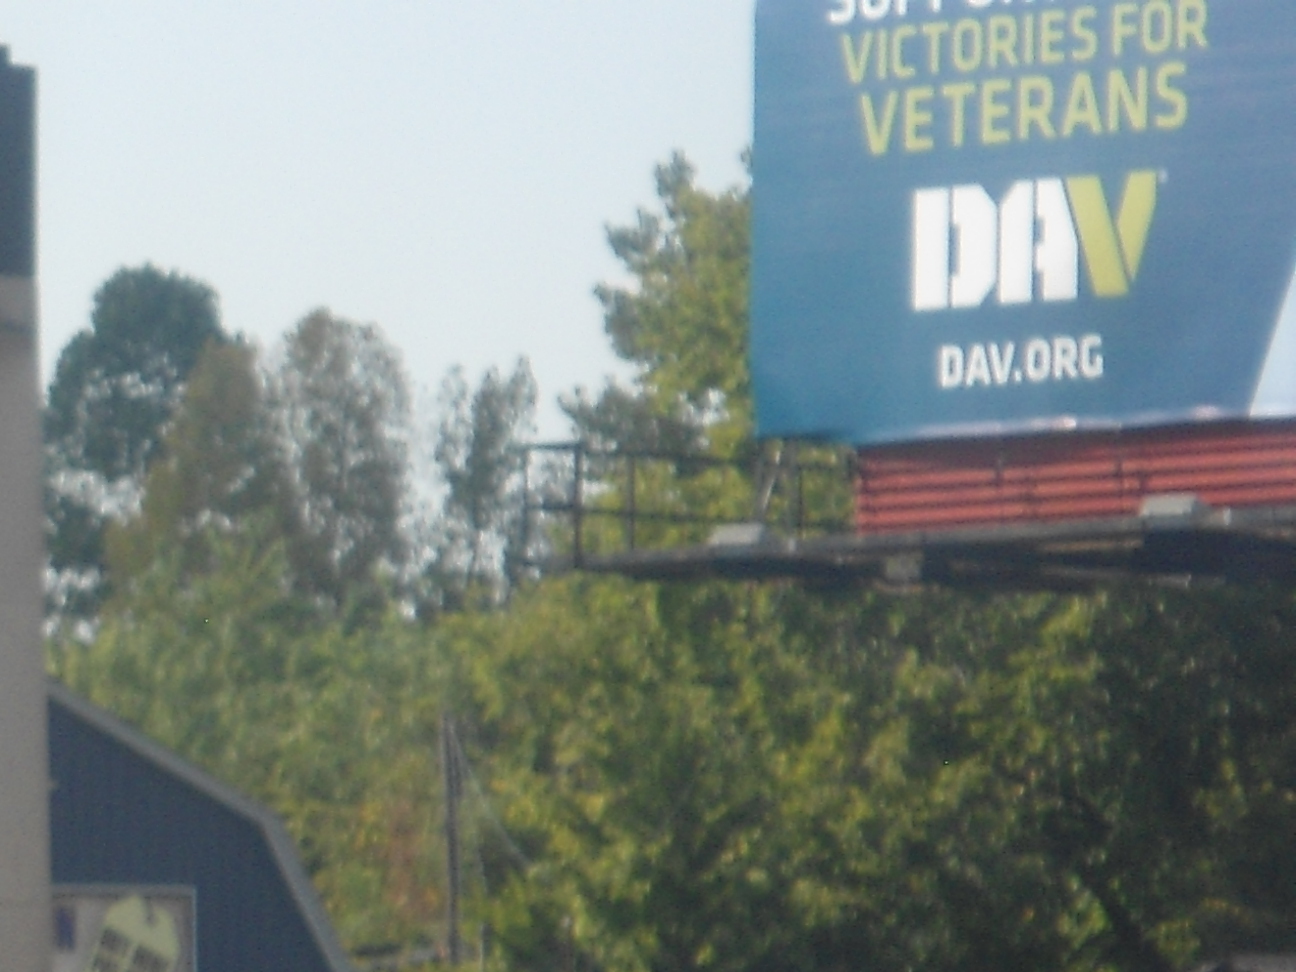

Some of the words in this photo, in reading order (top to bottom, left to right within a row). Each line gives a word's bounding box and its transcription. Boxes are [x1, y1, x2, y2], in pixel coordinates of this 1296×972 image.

[841, 5, 1099, 84] VICTORIES
[1111, 1, 1209, 56] FOR
[860, 62, 1189, 156] VETERANS
[911, 170, 1158, 312] DAV
[937, 334, 1104, 389] DAV.ORG
